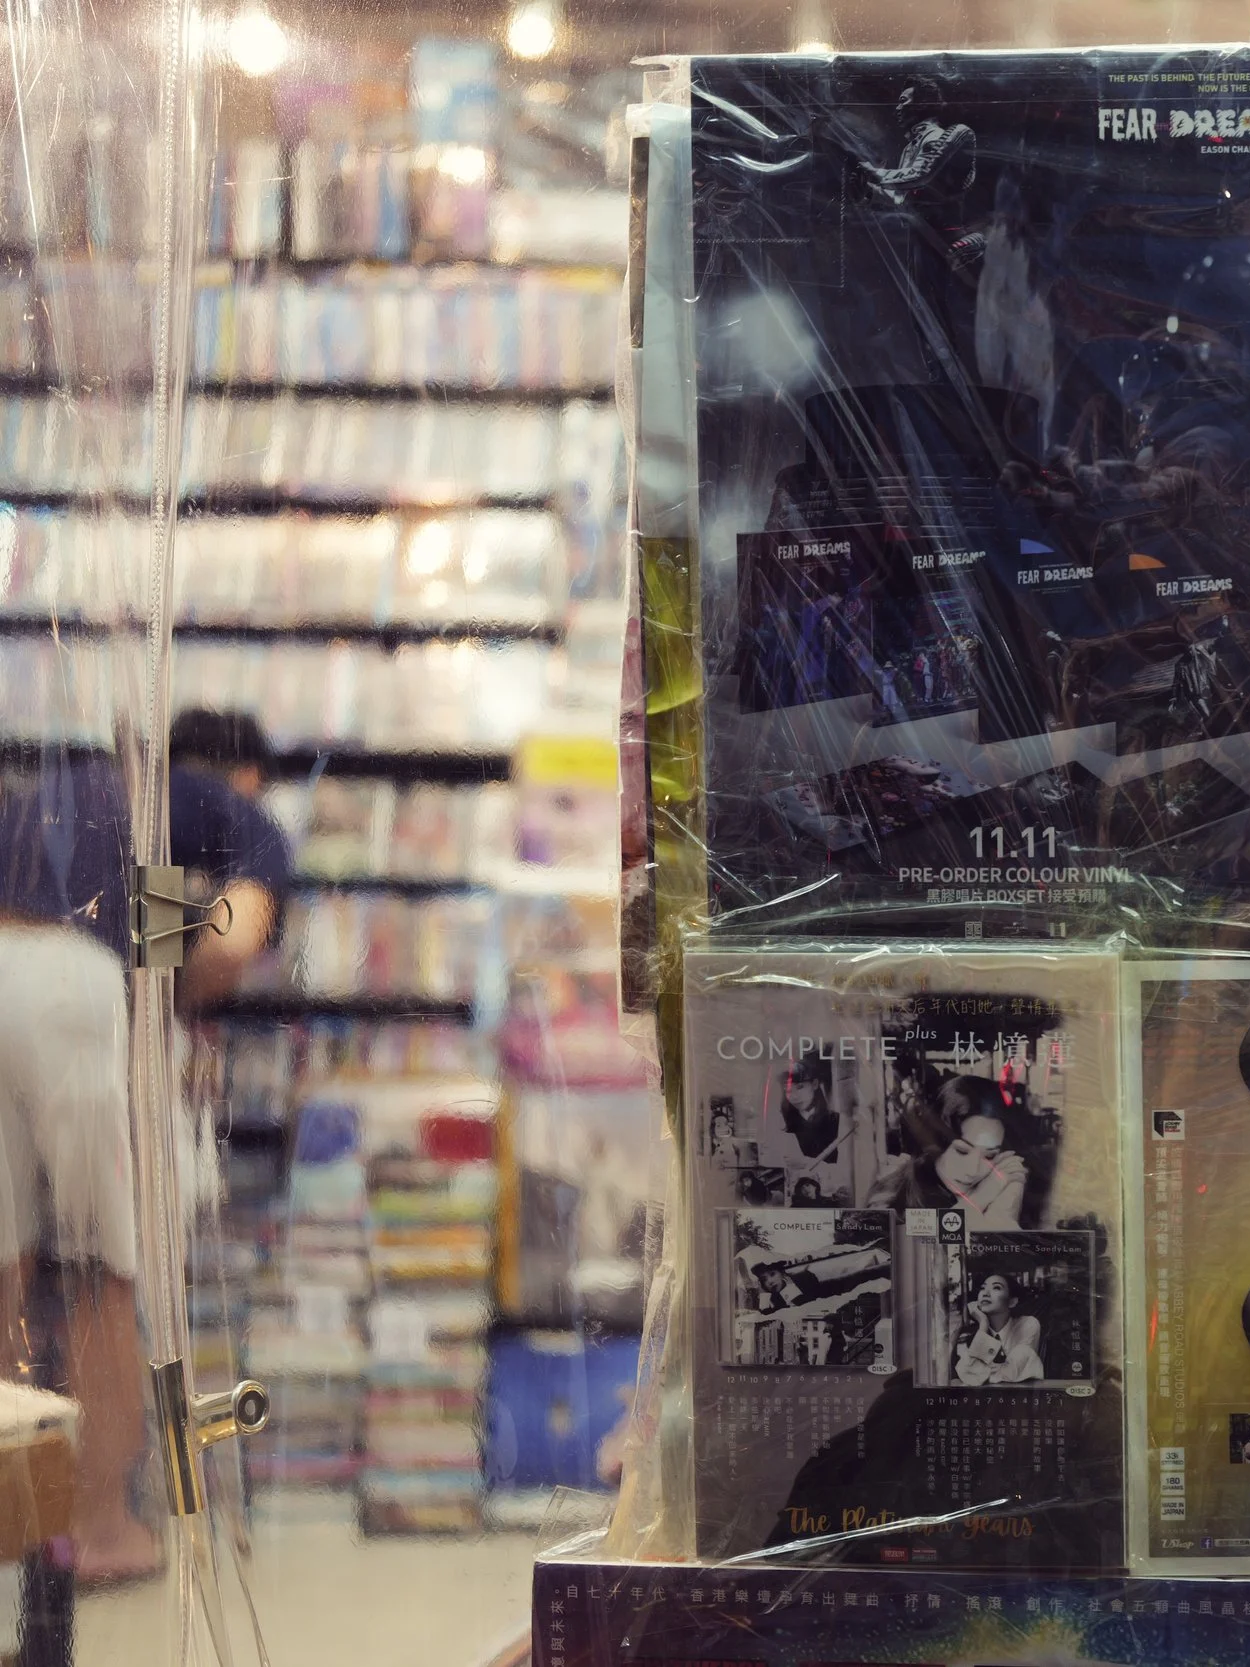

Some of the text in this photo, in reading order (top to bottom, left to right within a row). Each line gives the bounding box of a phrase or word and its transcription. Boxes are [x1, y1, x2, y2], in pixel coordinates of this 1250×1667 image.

[1109, 74, 1126, 83] THE
[1128, 74, 1149, 82] PAST
[1151, 74, 1160, 82] IS
[1161, 74, 1194, 82] BEHIND
[1199, 74, 1215, 82] THE
[1217, 73, 1250, 81] FUTURE
[1098, 108, 1158, 142] FEAR
[1201, 146, 1230, 154] EASON
[778, 542, 851, 559] FEAR DREAMS
[912, 555, 934, 569] FEAR
[1018, 567, 1094, 584] FEAR DREAMS
[1156, 578, 1232, 596] FEAR DREAMS
[969, 826, 1056, 858] 11.11
[900, 866, 1135, 883] PRE-ORDER COLOUR VINYL
[926, 888, 984, 903] 黑膠唱片
[986, 889, 1046, 903] BOXSET
[717, 1025, 1077, 1069] COMPLETE plus 林憶蓮
[773, 1222, 822, 1231] COMPLETE
[942, 1233, 962, 1241] MQA
[972, 1244, 1020, 1252] COMPLETE
[784, 1506, 832, 1534] The
